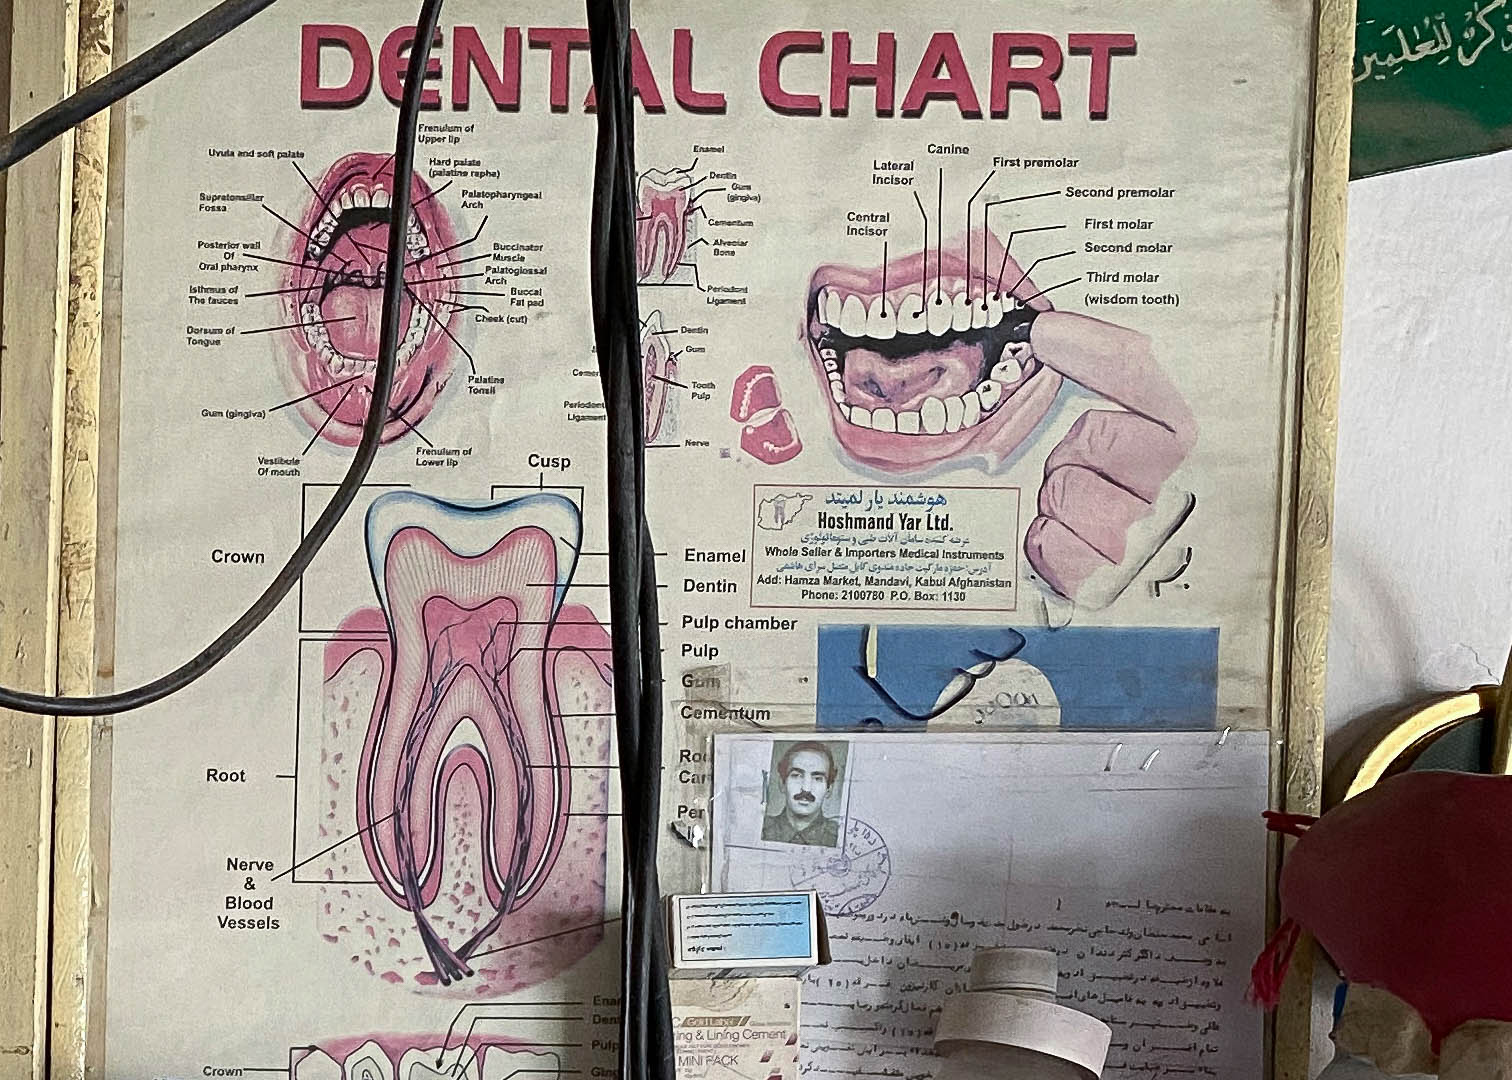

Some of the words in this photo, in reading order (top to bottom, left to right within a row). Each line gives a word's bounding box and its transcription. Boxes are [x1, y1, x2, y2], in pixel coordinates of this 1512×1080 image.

[759, 31, 1138, 119] CHART
[928, 143, 969, 154] Canine
[277, 151, 304, 159] palate
[873, 160, 914, 171] Lateral
[993, 158, 1021, 168] First
[1025, 158, 1079, 169] premolar
[873, 175, 914, 186] Incisor
[1066, 187, 1113, 198] Second
[1117, 187, 1175, 199] premolar
[847, 212, 889, 223] Central
[1085, 219, 1113, 229] First
[1116, 220, 1153, 230] molar
[847, 226, 888, 236] Incisor
[198, 241, 239, 249] Posterior
[1085, 242, 1132, 253] Second
[1136, 242, 1172, 254] molar
[199, 263, 218, 271] Oral
[221, 264, 258, 272] pharynx
[1086, 272, 1115, 282] Third
[1123, 272, 1159, 283] molar
[1085, 294, 1137, 307] (wisdom
[1140, 294, 1179, 307] tooth)
[692, 382, 715, 390] Tooth
[692, 392, 710, 400] Pulp
[226, 410, 265, 419] (gingiva)
[529, 454, 570, 470] Cusp
[818, 512, 894, 530] Hoshmand
[899, 513, 921, 530] Yar
[927, 514, 953, 531] Ltd.
[212, 550, 264, 563] Crown
[685, 549, 746, 563] Enamel
[766, 547, 798, 556] Whole
[836, 548, 842, 557] &
[846, 548, 896, 559] Importers
[900, 549, 938, 558] Medical
[942, 550, 1004, 560] Instruments
[684, 579, 737, 593] Dentin
[758, 576, 781, 585] Add:
[785, 576, 820, 586] Hamza
[824, 576, 860, 587] Market,
[865, 577, 911, 588] Mandavi,
[916, 578, 945, 586] Kabul
[948, 578, 1011, 589] Afghanistan
[801, 590, 838, 600] Phone:
[842, 591, 884, 600] 2100780
[890, 592, 911, 600] P.O.
[915, 592, 938, 600] Box:
[942, 592, 965, 601] 1130
[682, 616, 719, 630] Pulp
[725, 616, 797, 630] chamber
[682, 644, 719, 659] Pulp
[682, 674, 720, 688] Gum
[681, 707, 770, 720] Cementum
[207, 770, 245, 782] Root
[227, 859, 274, 871] Nerve
[244, 878, 255, 889] &
[226, 897, 273, 910] Blood
[218, 916, 280, 929] Vessels
[696, 1032, 704, 1040] &
[707, 1028, 739, 1042] Lining
[203, 1066, 243, 1076] Crown
